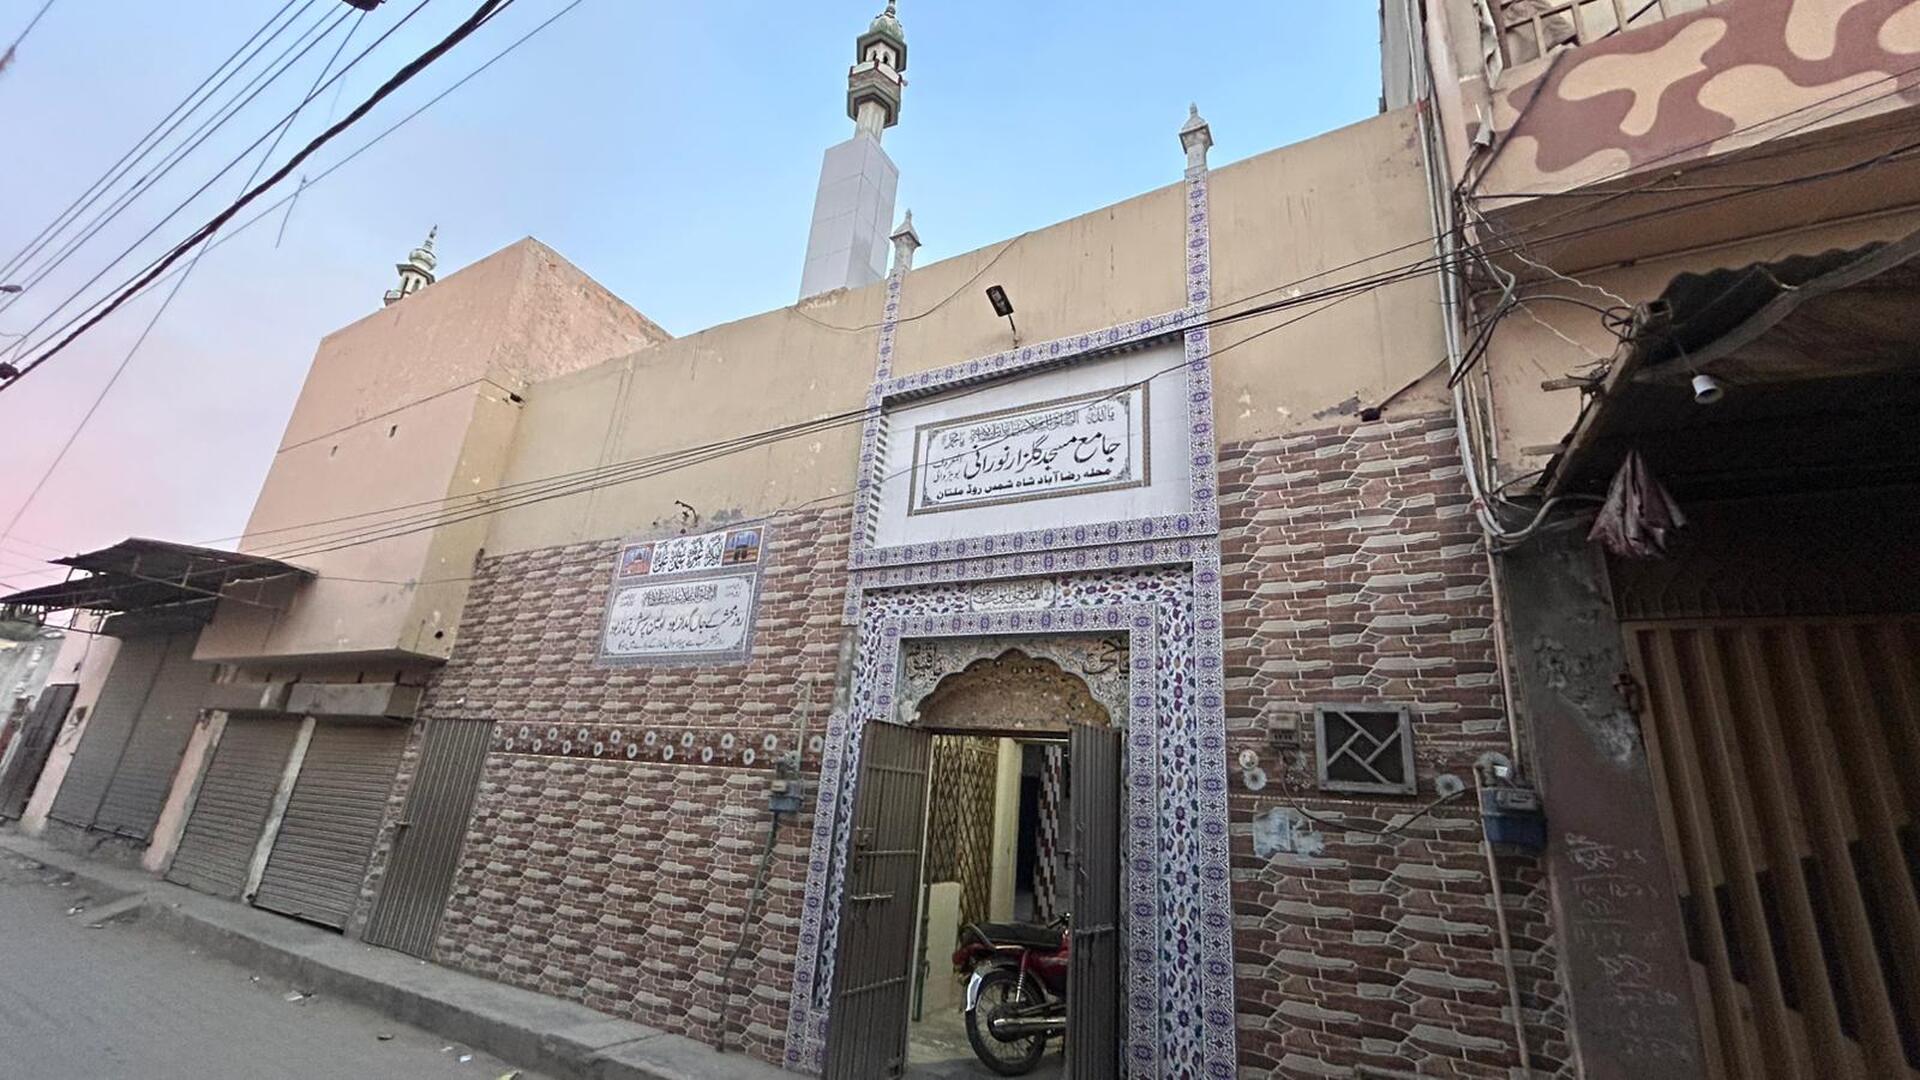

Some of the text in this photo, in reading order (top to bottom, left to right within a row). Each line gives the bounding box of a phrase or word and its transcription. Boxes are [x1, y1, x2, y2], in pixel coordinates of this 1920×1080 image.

[1033, 435, 1077, 471] مسجد
[1074, 431, 1121, 463] جامع
[1083, 467, 1112, 478] محلہ
[936, 488, 964, 500] ملتان
